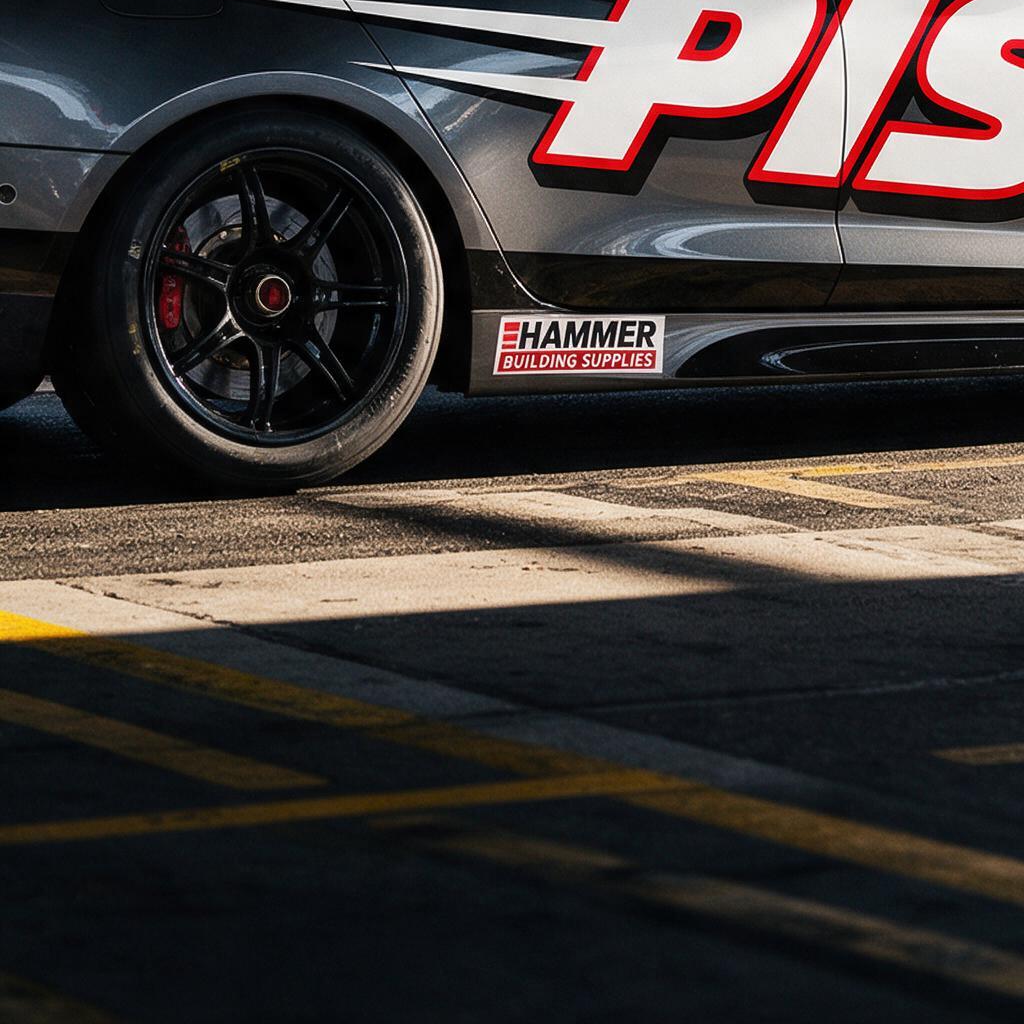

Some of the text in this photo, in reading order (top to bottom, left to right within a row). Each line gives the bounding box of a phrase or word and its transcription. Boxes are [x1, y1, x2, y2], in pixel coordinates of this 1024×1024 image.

[518, 320, 657, 350] HAMMER
[502, 351, 654, 370] BUILDING SUPPLIES
